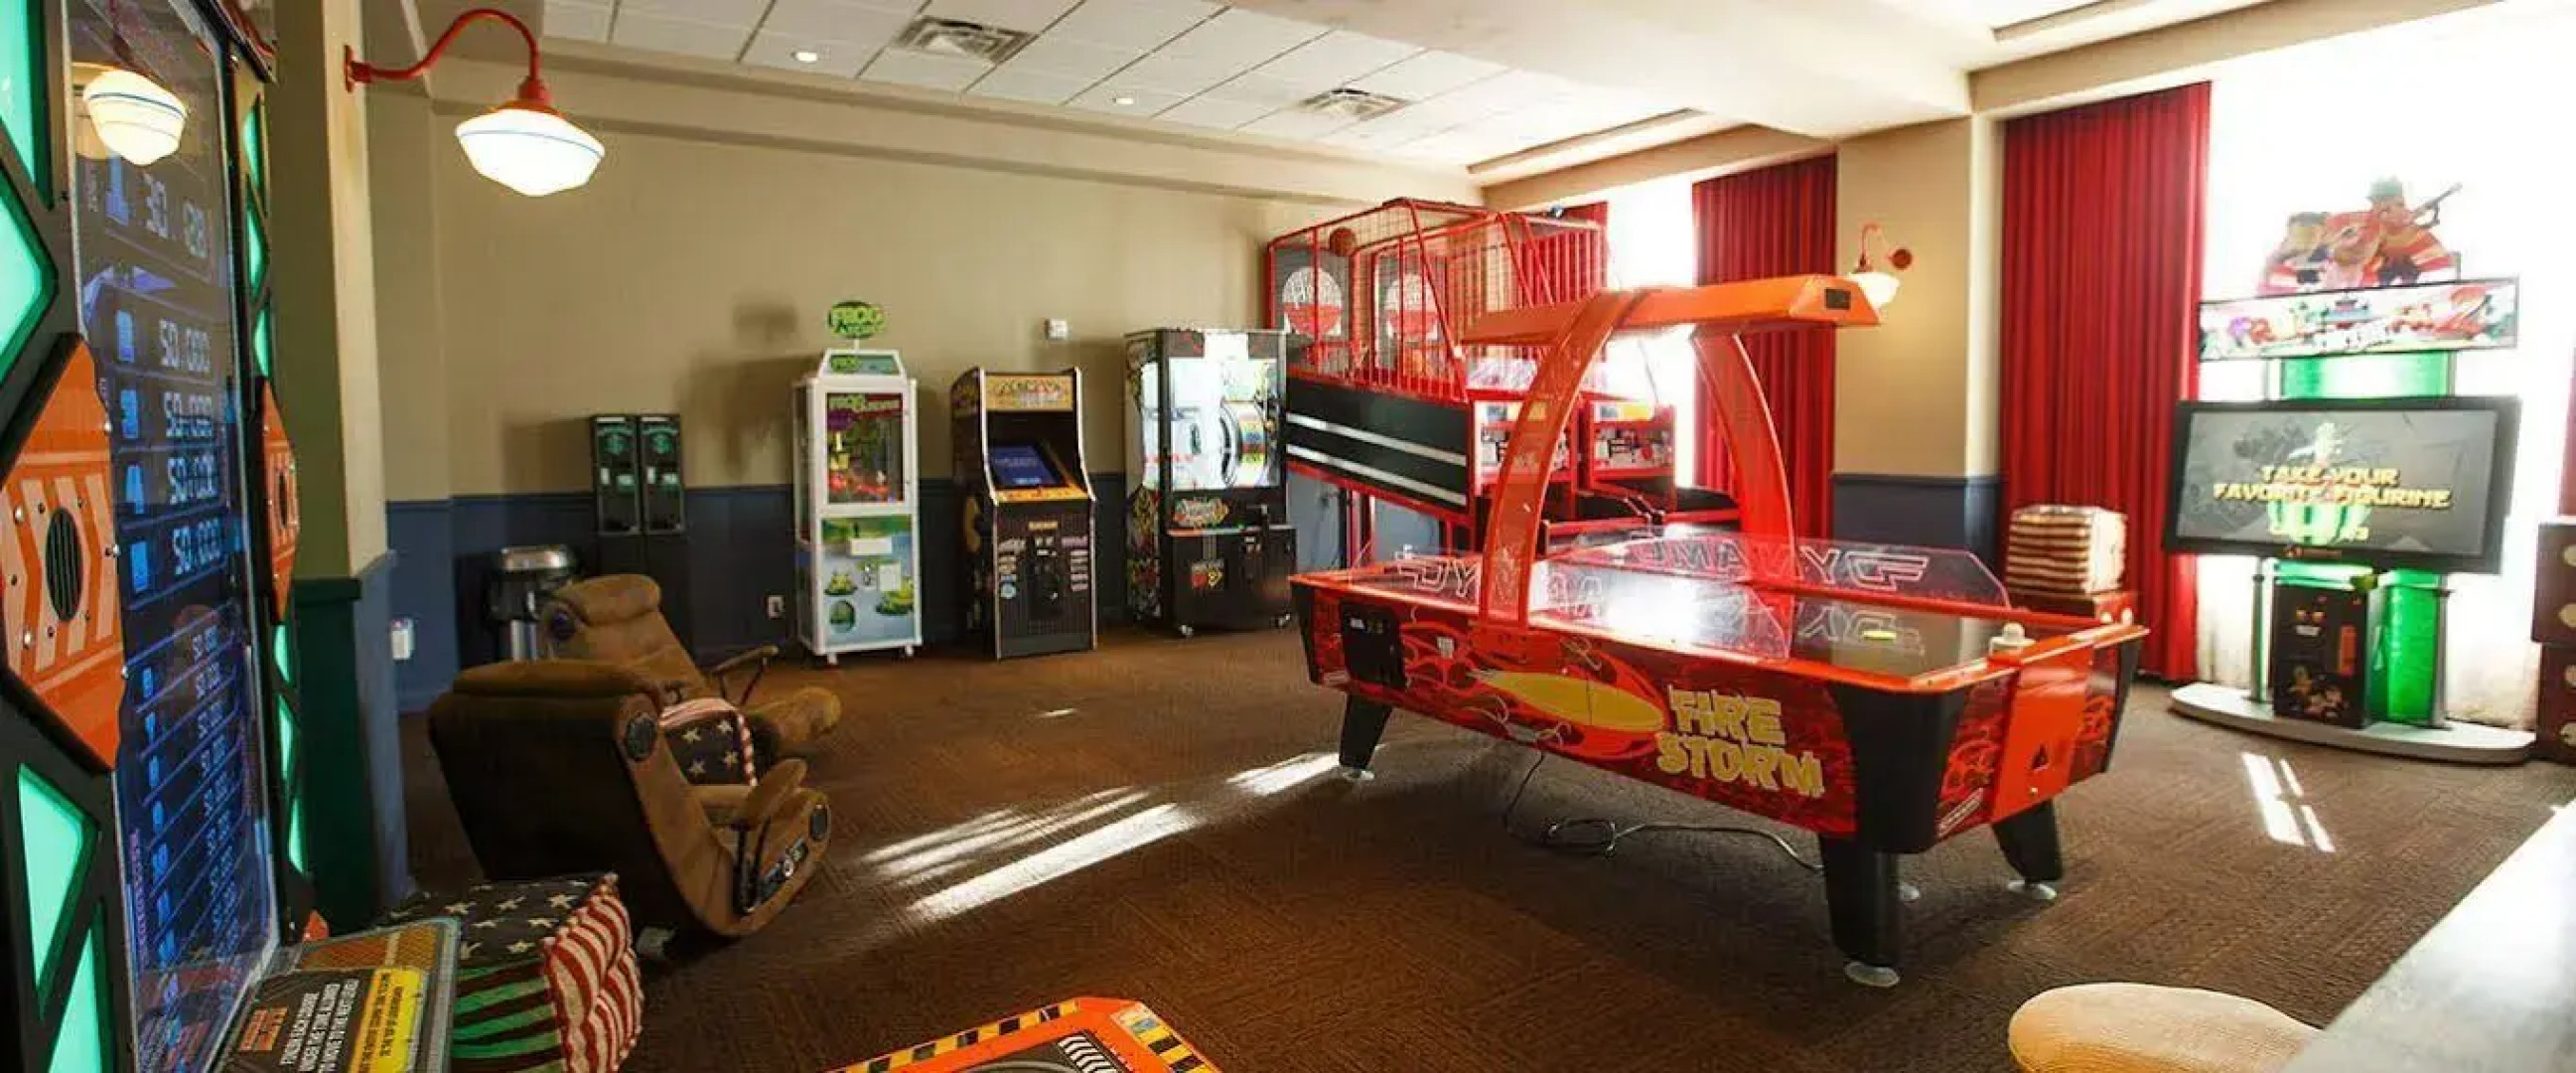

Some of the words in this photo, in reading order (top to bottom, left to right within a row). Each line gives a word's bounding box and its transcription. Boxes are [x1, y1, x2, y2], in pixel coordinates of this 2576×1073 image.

[2214, 482, 2322, 504] FAVORITE
[2333, 485, 2453, 509] FIGURINE
[2261, 465, 2323, 486] TAKE
[2332, 467, 2401, 488] YOUR
[1667, 683, 1787, 745] FIRE
[1655, 731, 1825, 799] STORM
